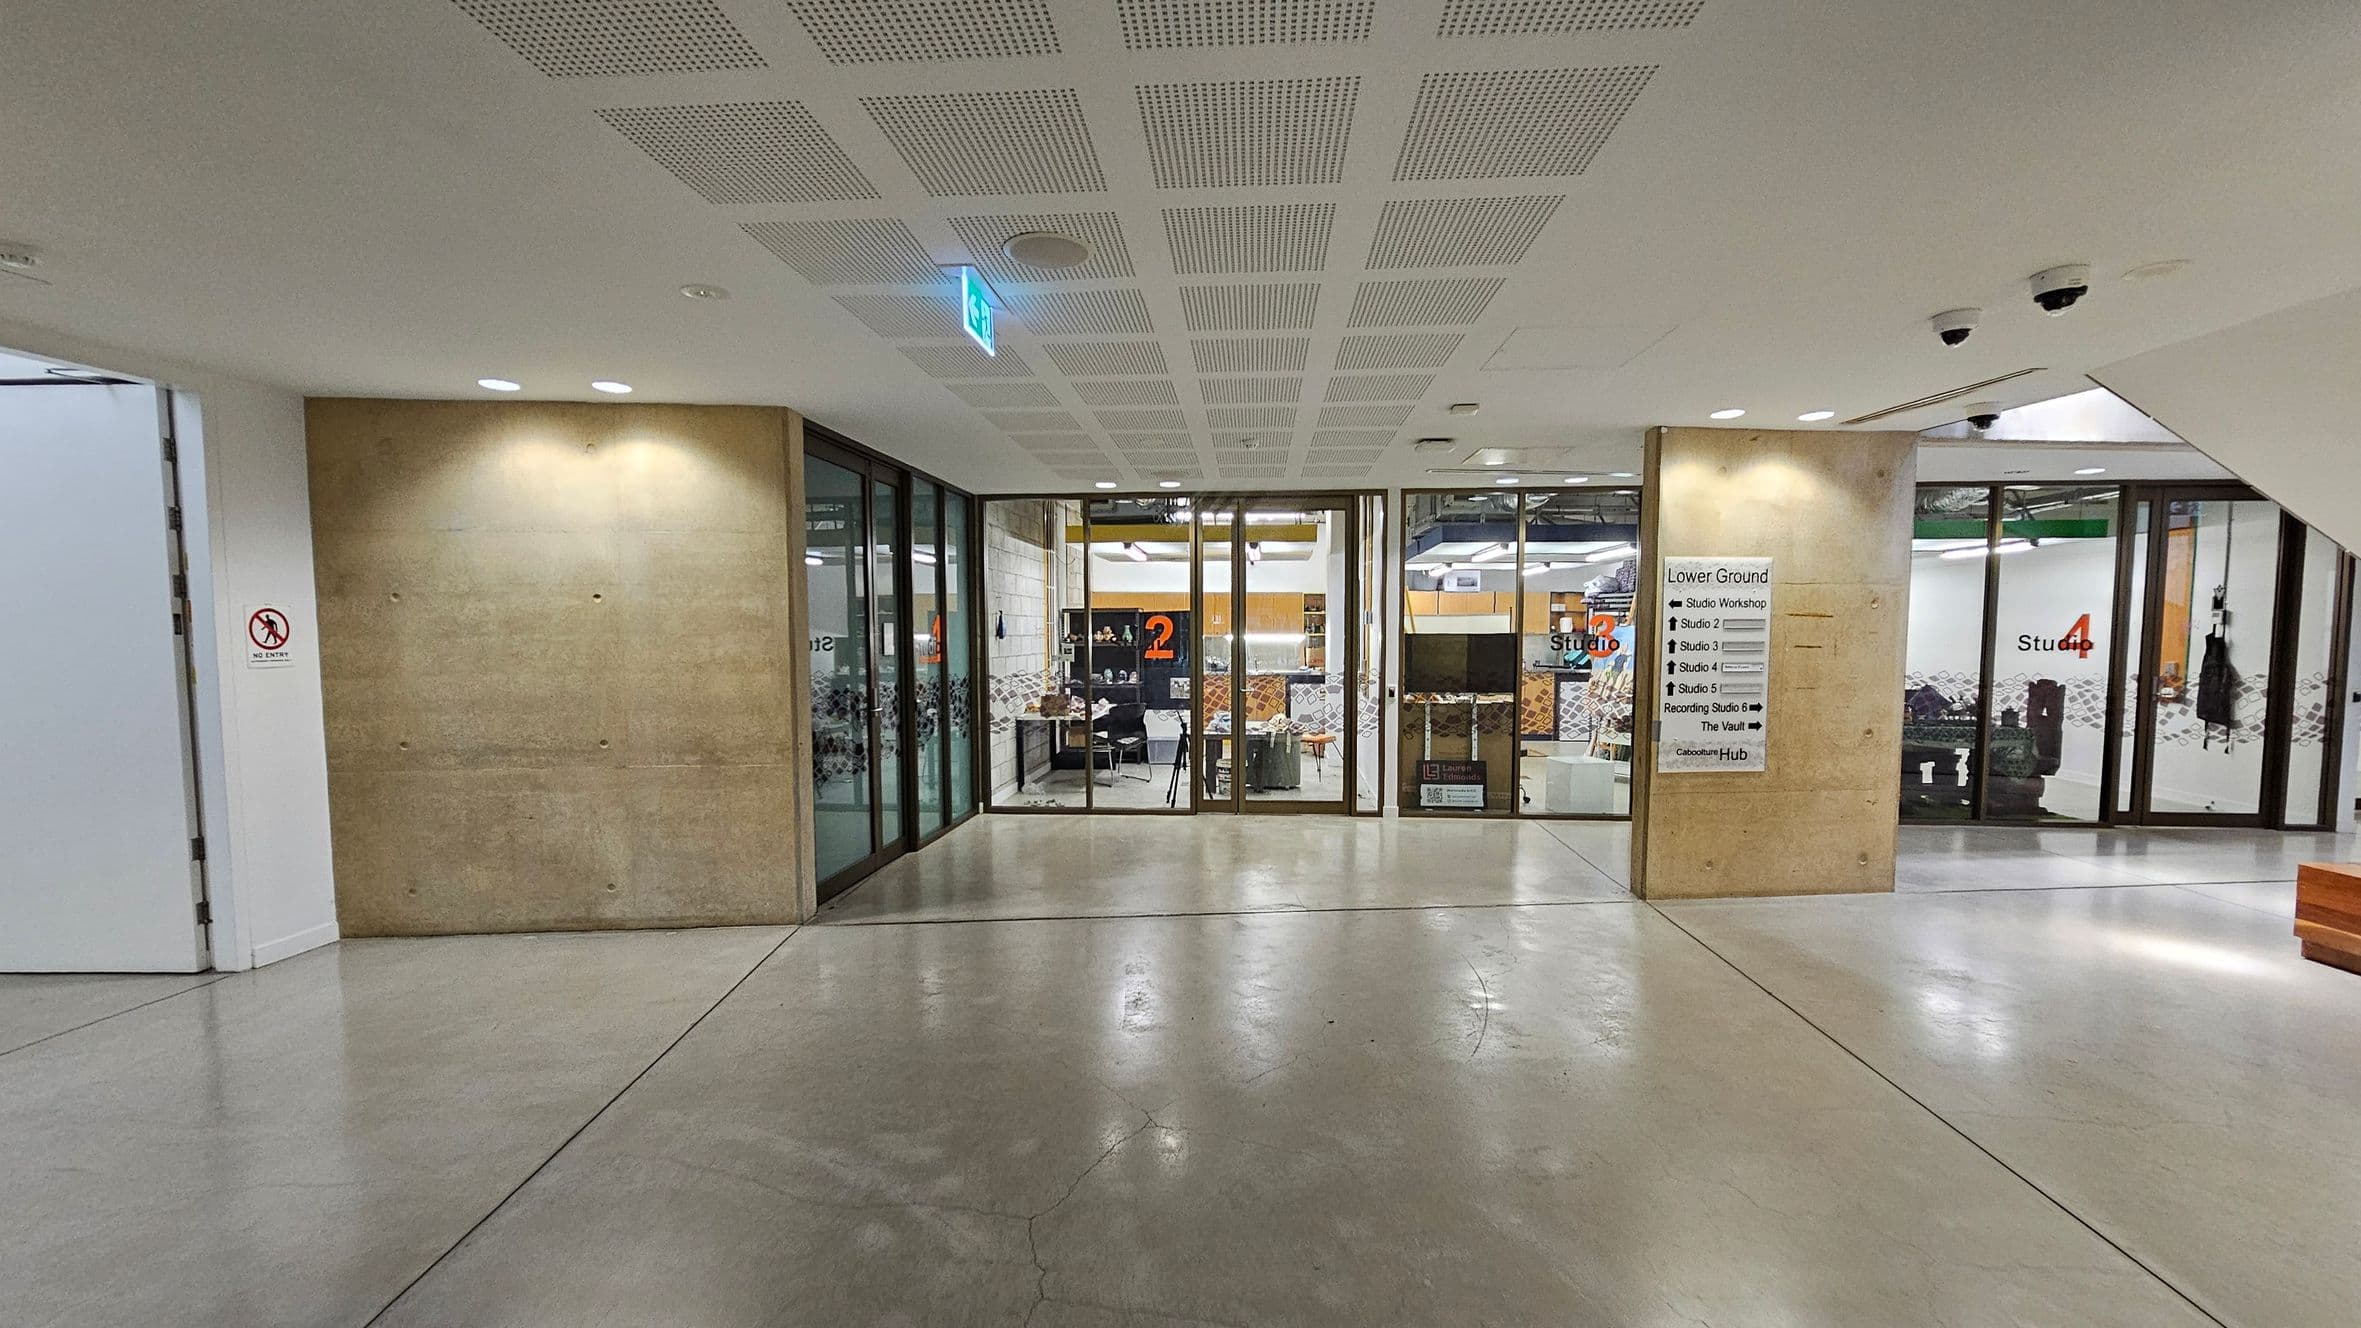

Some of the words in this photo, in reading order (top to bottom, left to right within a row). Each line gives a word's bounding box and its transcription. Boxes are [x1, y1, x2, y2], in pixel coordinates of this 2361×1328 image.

[1668, 568, 1712, 584] Lower
[1716, 568, 1769, 584] Ground
[1686, 598, 1716, 608] Studio
[1719, 598, 1767, 610] Workshop
[1681, 618, 1711, 629] Studio
[1713, 619, 1720, 629] 2
[1144, 615, 1174, 659] 2
[1551, 635, 1620, 651] Studio
[1589, 614, 1616, 657] 3
[2018, 634, 2093, 651] Studio
[2059, 613, 2093, 659] 4
[1679, 641, 1710, 651] Studio
[1712, 641, 1719, 651] 3
[1679, 662, 1709, 672] Studio
[1711, 662, 1718, 672] 4
[1678, 683, 1709, 693] Studio
[1711, 684, 1717, 693] 5
[1664, 703, 1709, 715] Recording
[1711, 702, 1740, 713] Studio
[1742, 703, 1748, 712] 6
[1701, 721, 1719, 732] The
[1721, 721, 1745, 731] Vault
[1676, 748, 1719, 756] Caboolture
[1719, 748, 1748, 761] Hub
